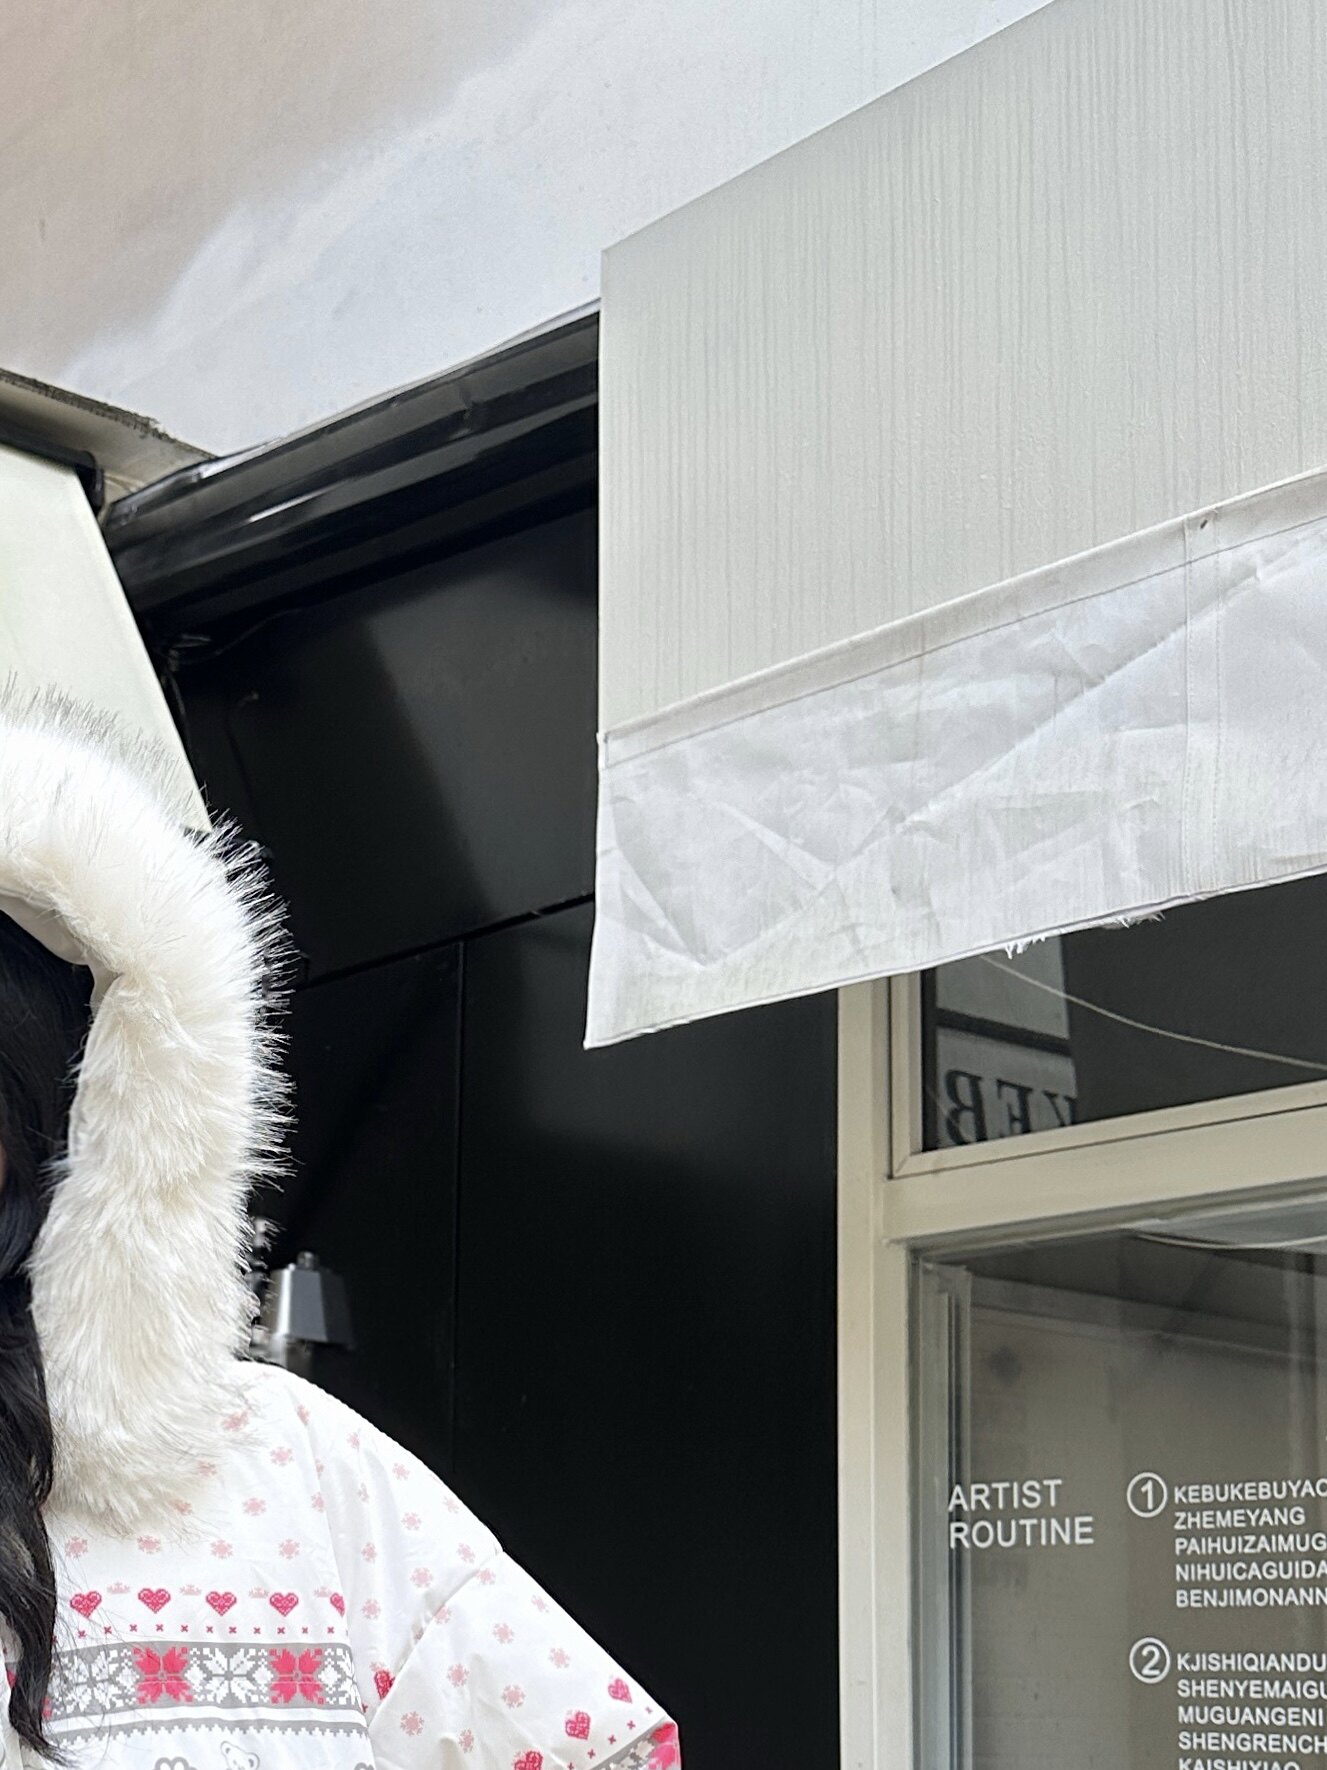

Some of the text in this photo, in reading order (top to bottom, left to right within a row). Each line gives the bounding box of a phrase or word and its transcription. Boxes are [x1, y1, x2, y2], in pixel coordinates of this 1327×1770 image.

[948, 1479, 1063, 1512] ARTIST
[1174, 1506, 1306, 1530] ZHEMEYANG
[949, 1516, 1095, 1549] ROUTINE
[1175, 1532, 1327, 1555] PAIHUIZAIMUG
[1177, 1652, 1327, 1673] KJISHIQIANDU
[1178, 1705, 1324, 1726] MUGUANGENI
